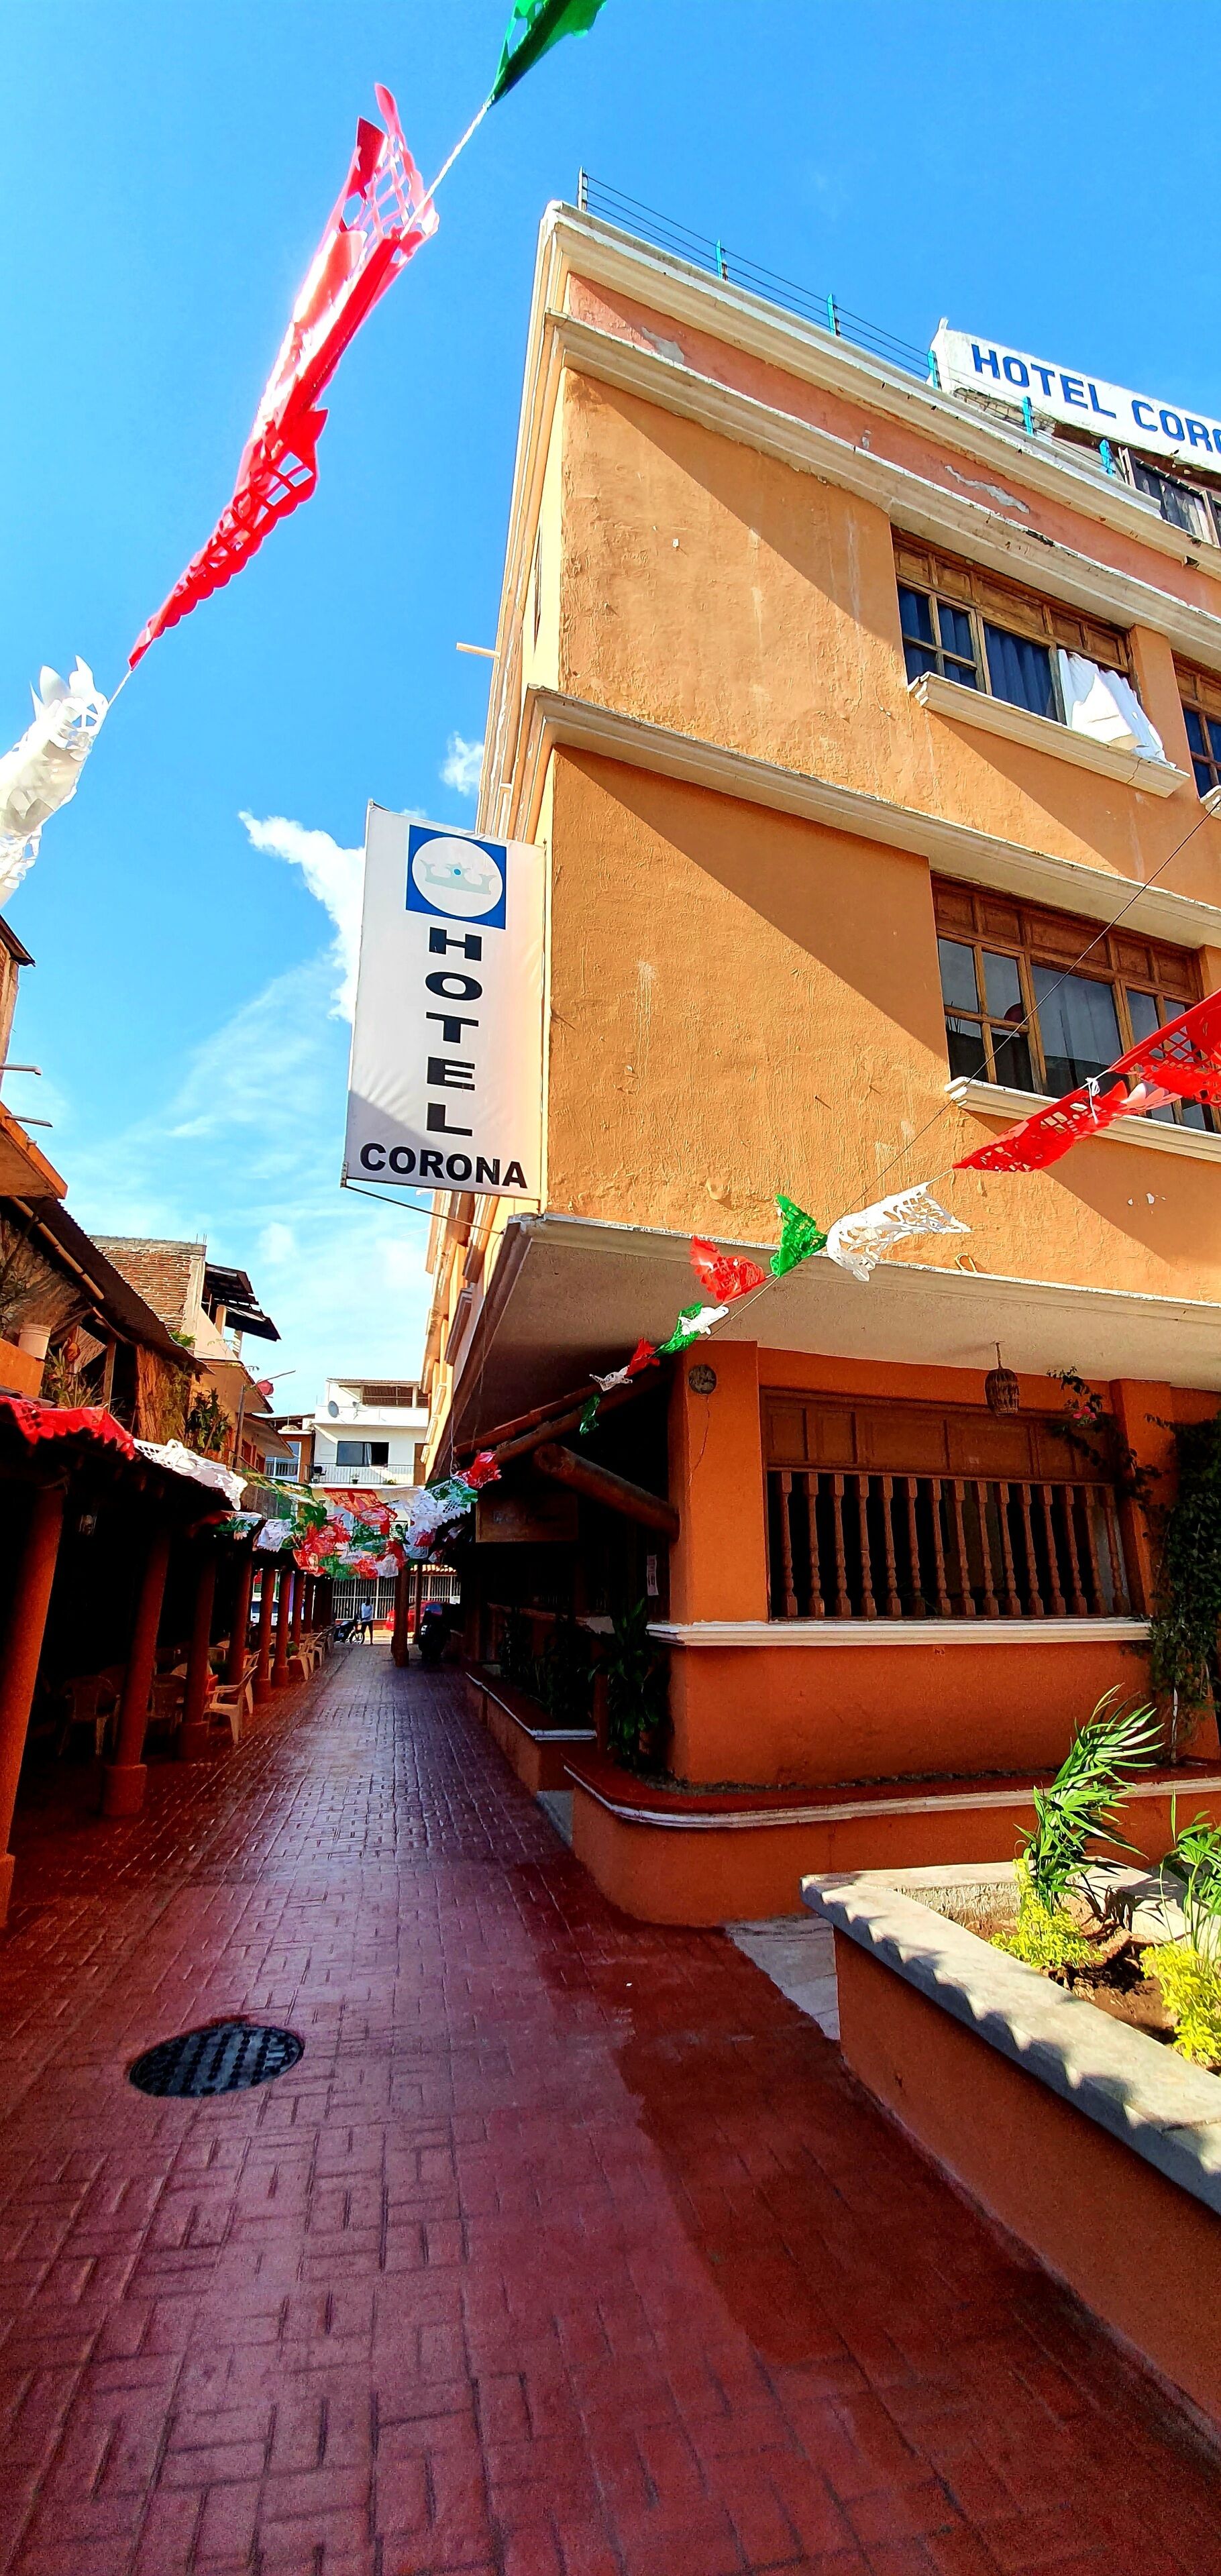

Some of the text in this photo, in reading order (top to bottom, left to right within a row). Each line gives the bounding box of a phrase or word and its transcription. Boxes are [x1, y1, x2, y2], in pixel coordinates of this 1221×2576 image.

[971, 343, 1116, 419] HOTEL
[425, 926, 483, 1137] HOTEL
[360, 1142, 527, 1189] CORONA
